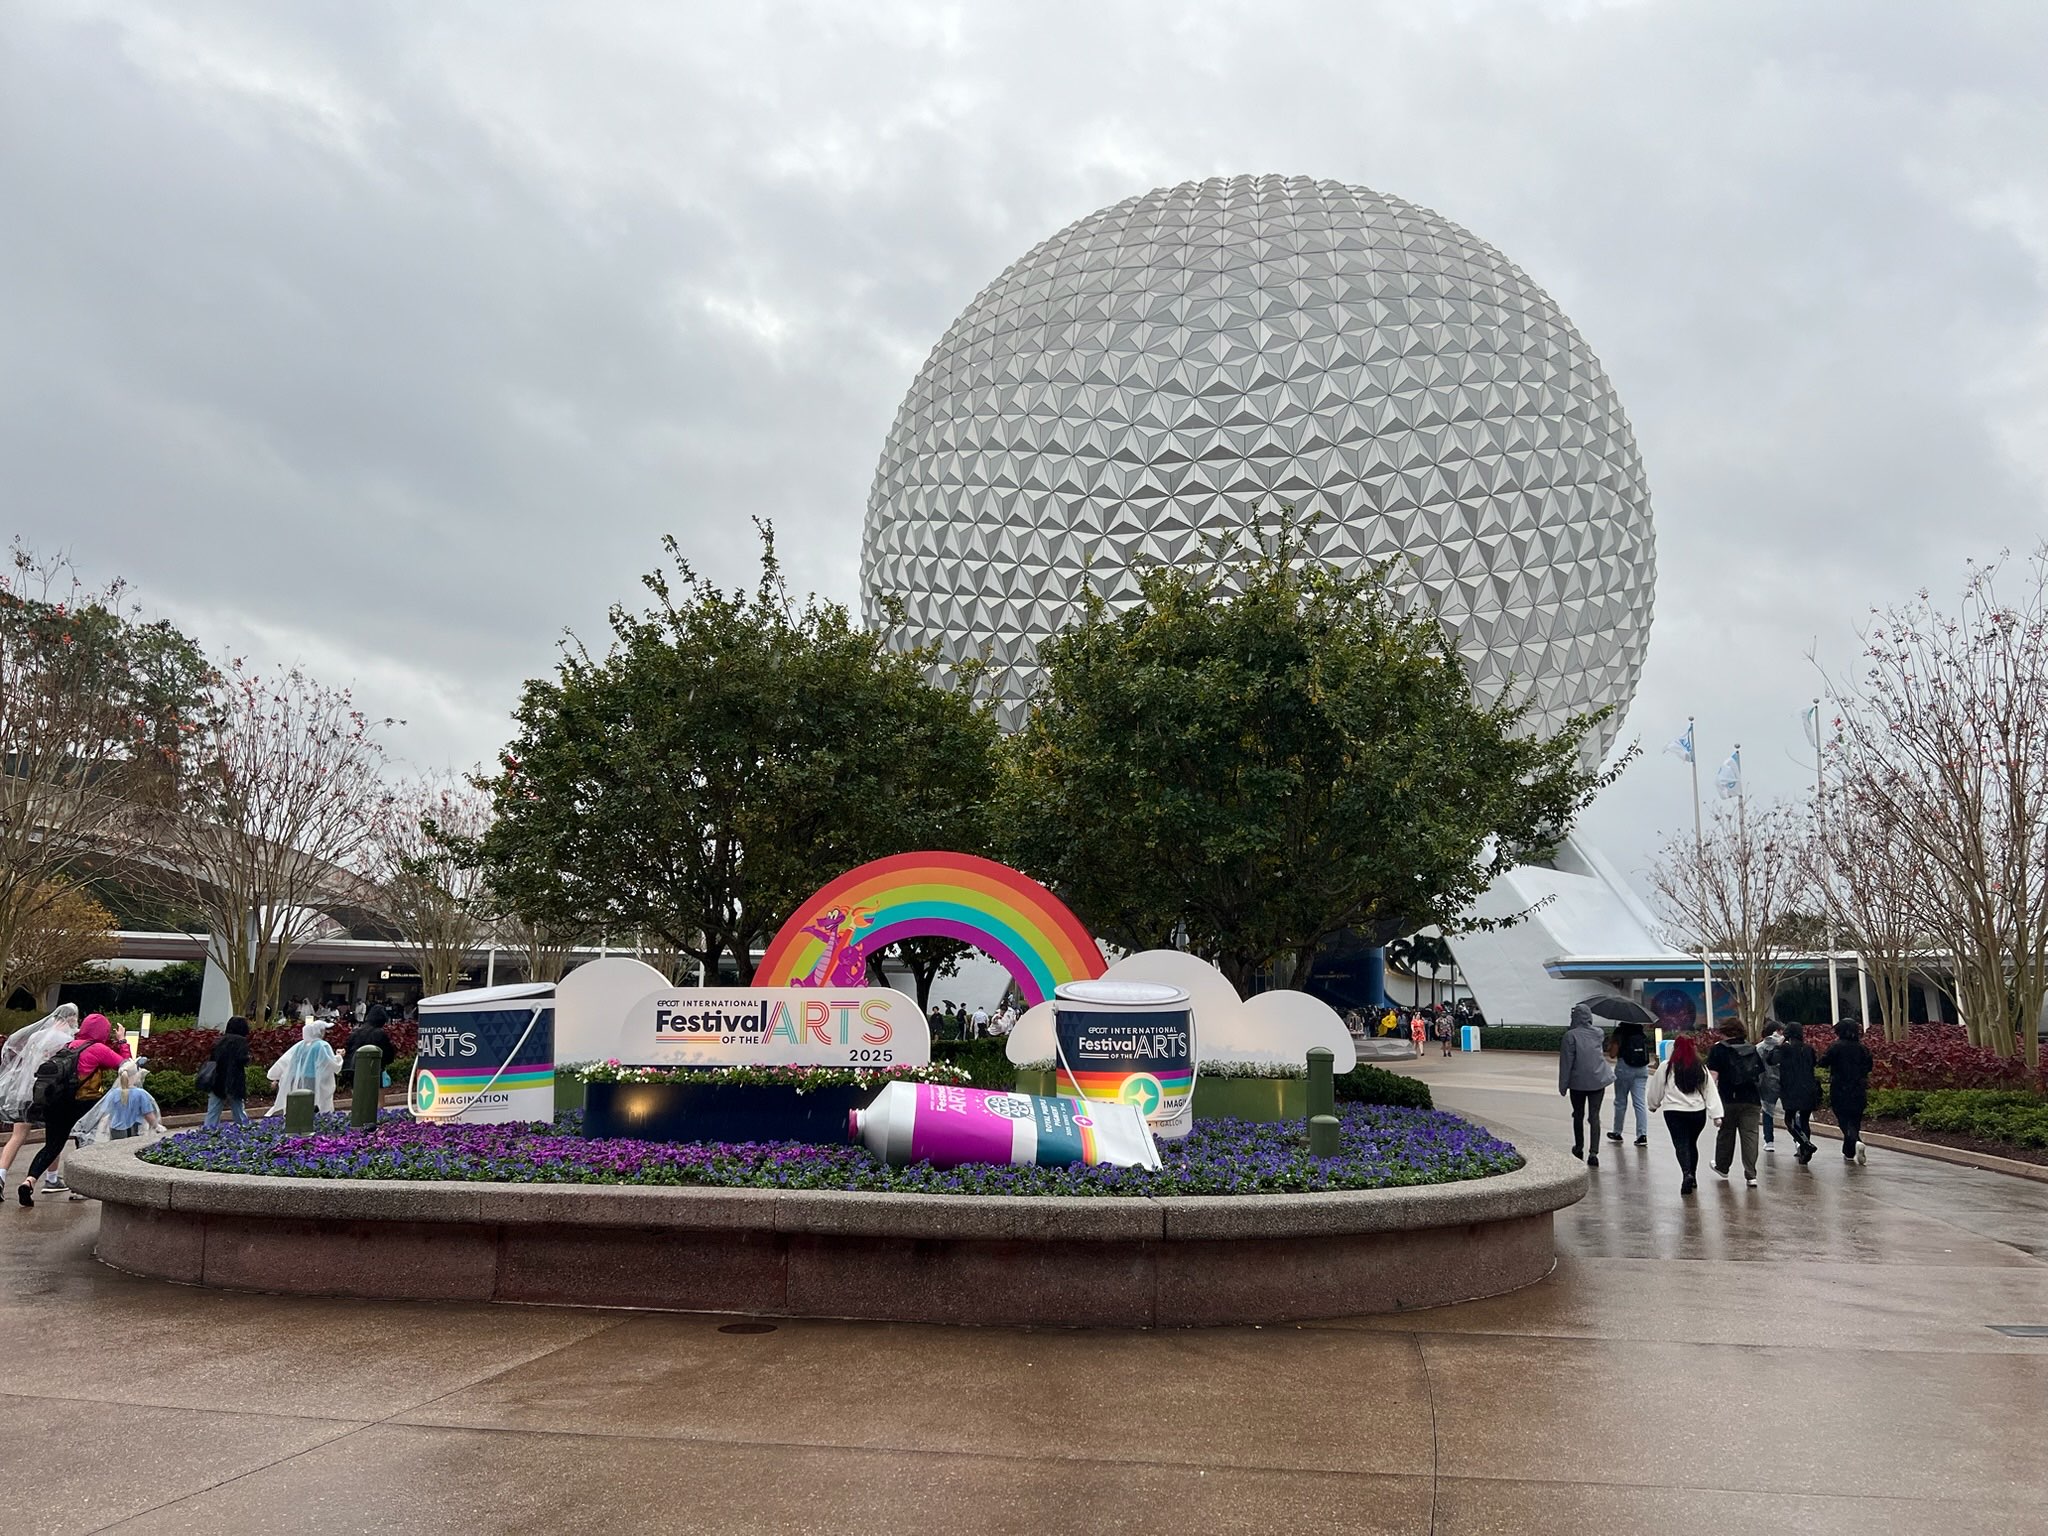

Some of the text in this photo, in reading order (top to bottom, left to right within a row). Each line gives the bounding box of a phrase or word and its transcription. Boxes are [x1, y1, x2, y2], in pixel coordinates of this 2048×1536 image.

[656, 1000, 892, 1045] Festival ARTS
[421, 1033, 477, 1057] ARTS
[722, 1036, 759, 1044] OF THE
[1079, 1033, 1187, 1059] Festival ARTS
[849, 1050, 892, 1062] 2025
[438, 1094, 509, 1104] IMAGINATION
